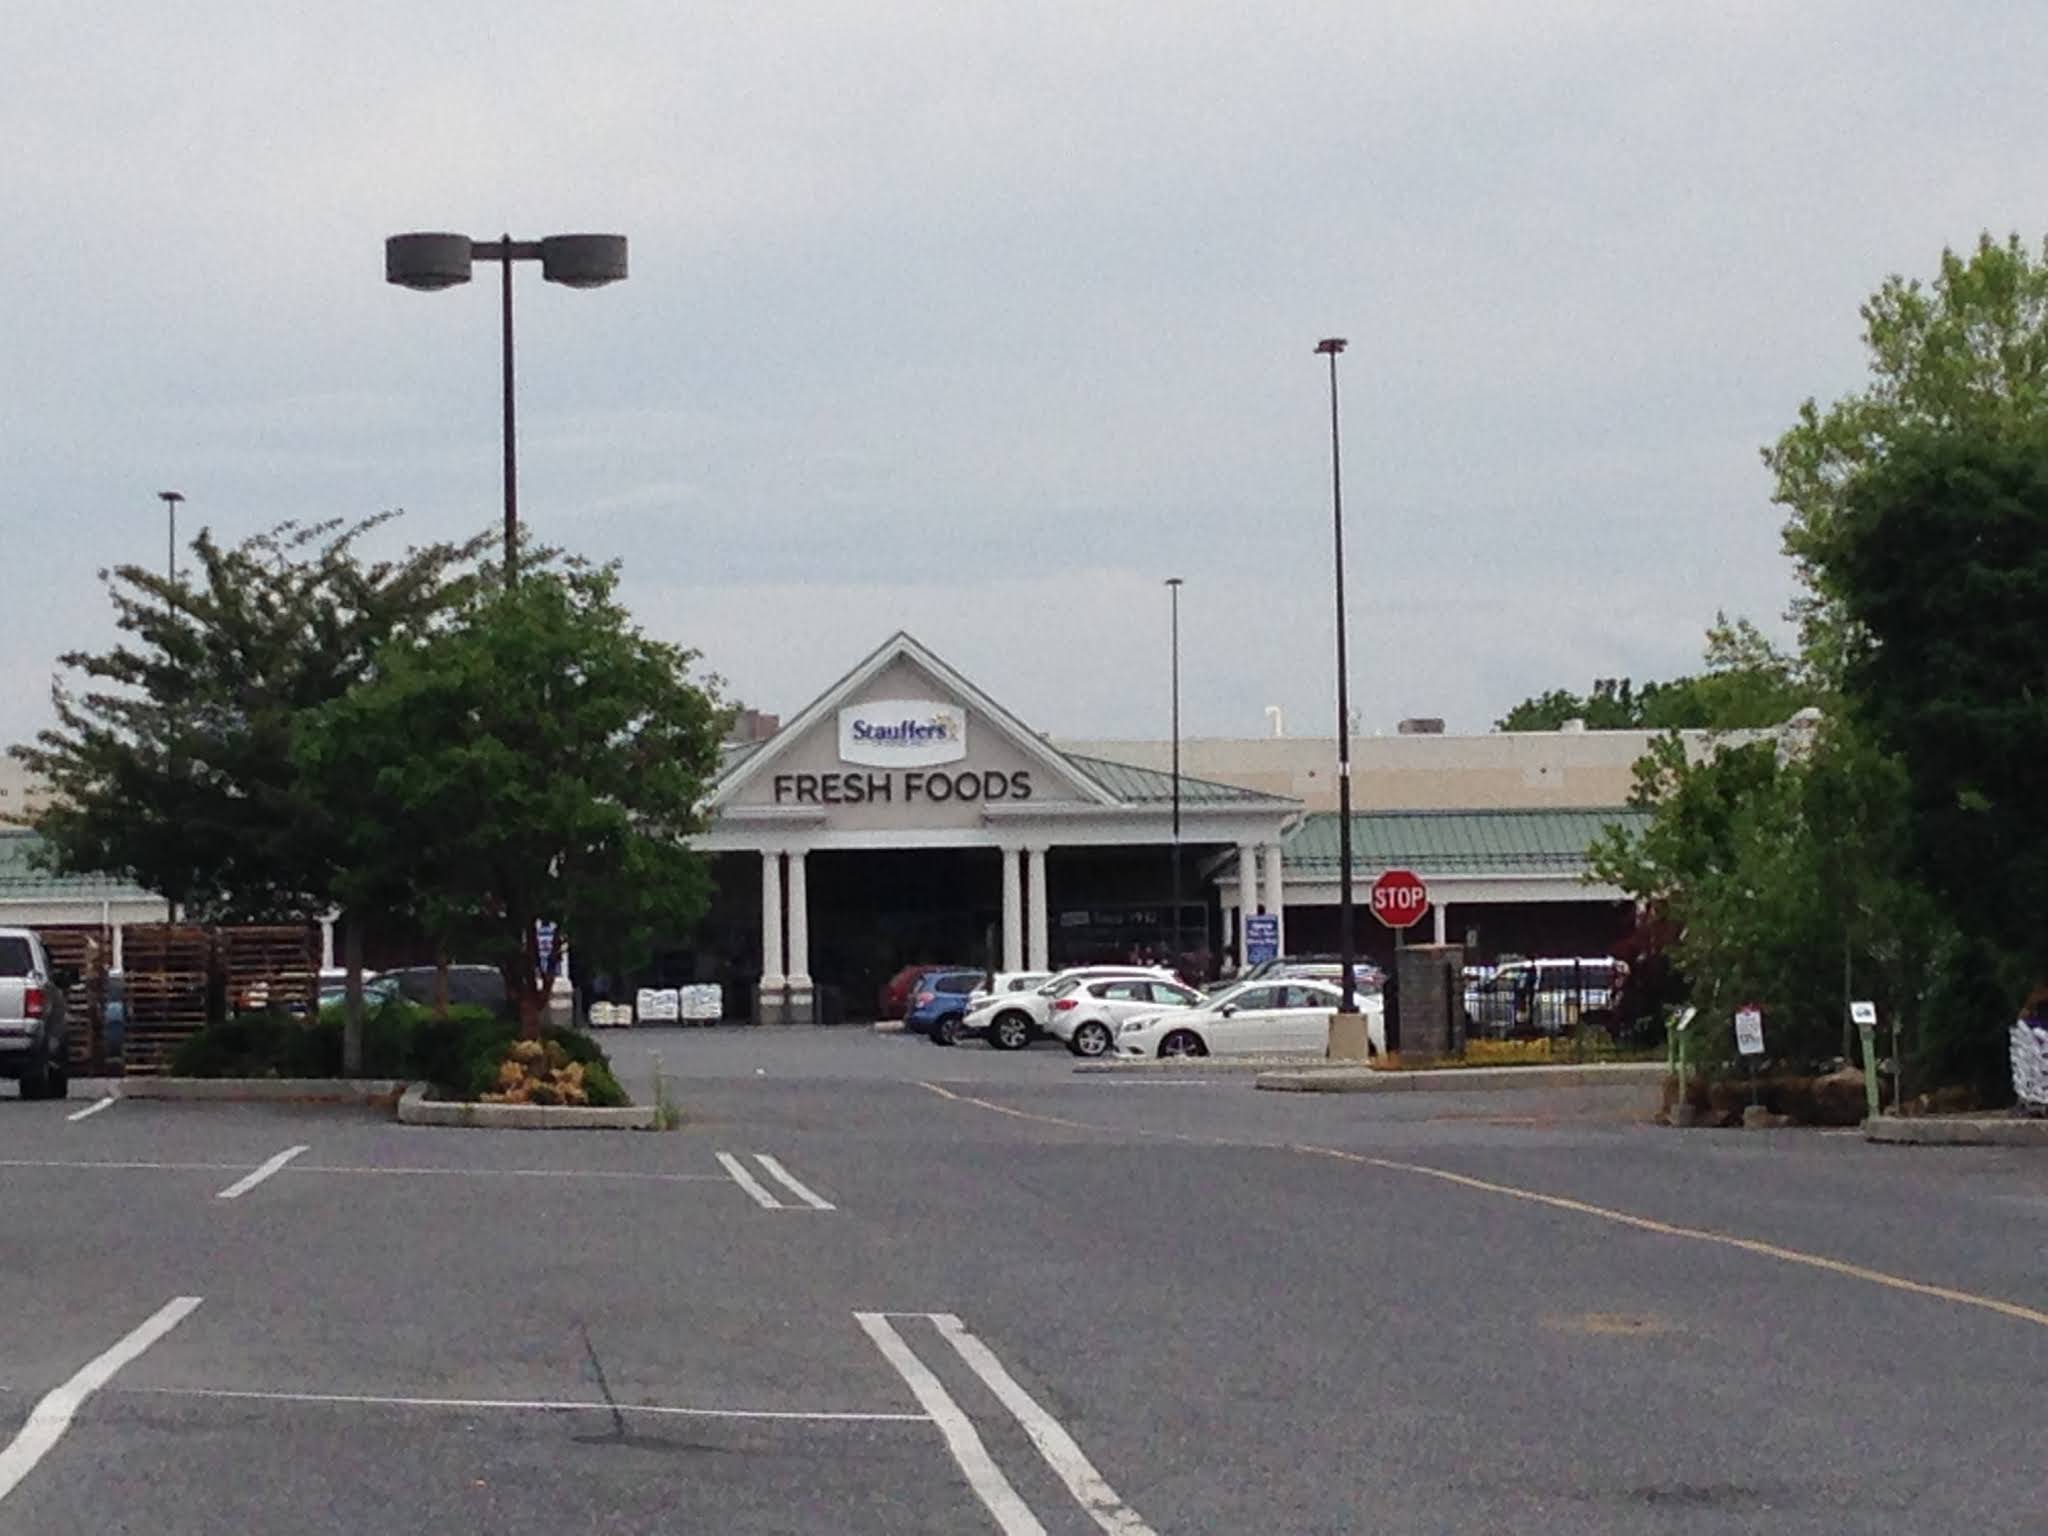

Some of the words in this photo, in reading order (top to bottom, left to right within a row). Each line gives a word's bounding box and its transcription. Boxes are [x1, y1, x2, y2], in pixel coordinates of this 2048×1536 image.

[774, 772, 892, 804] FRESH
[905, 771, 1033, 803] FOODS
[1374, 886, 1425, 910] STOP
